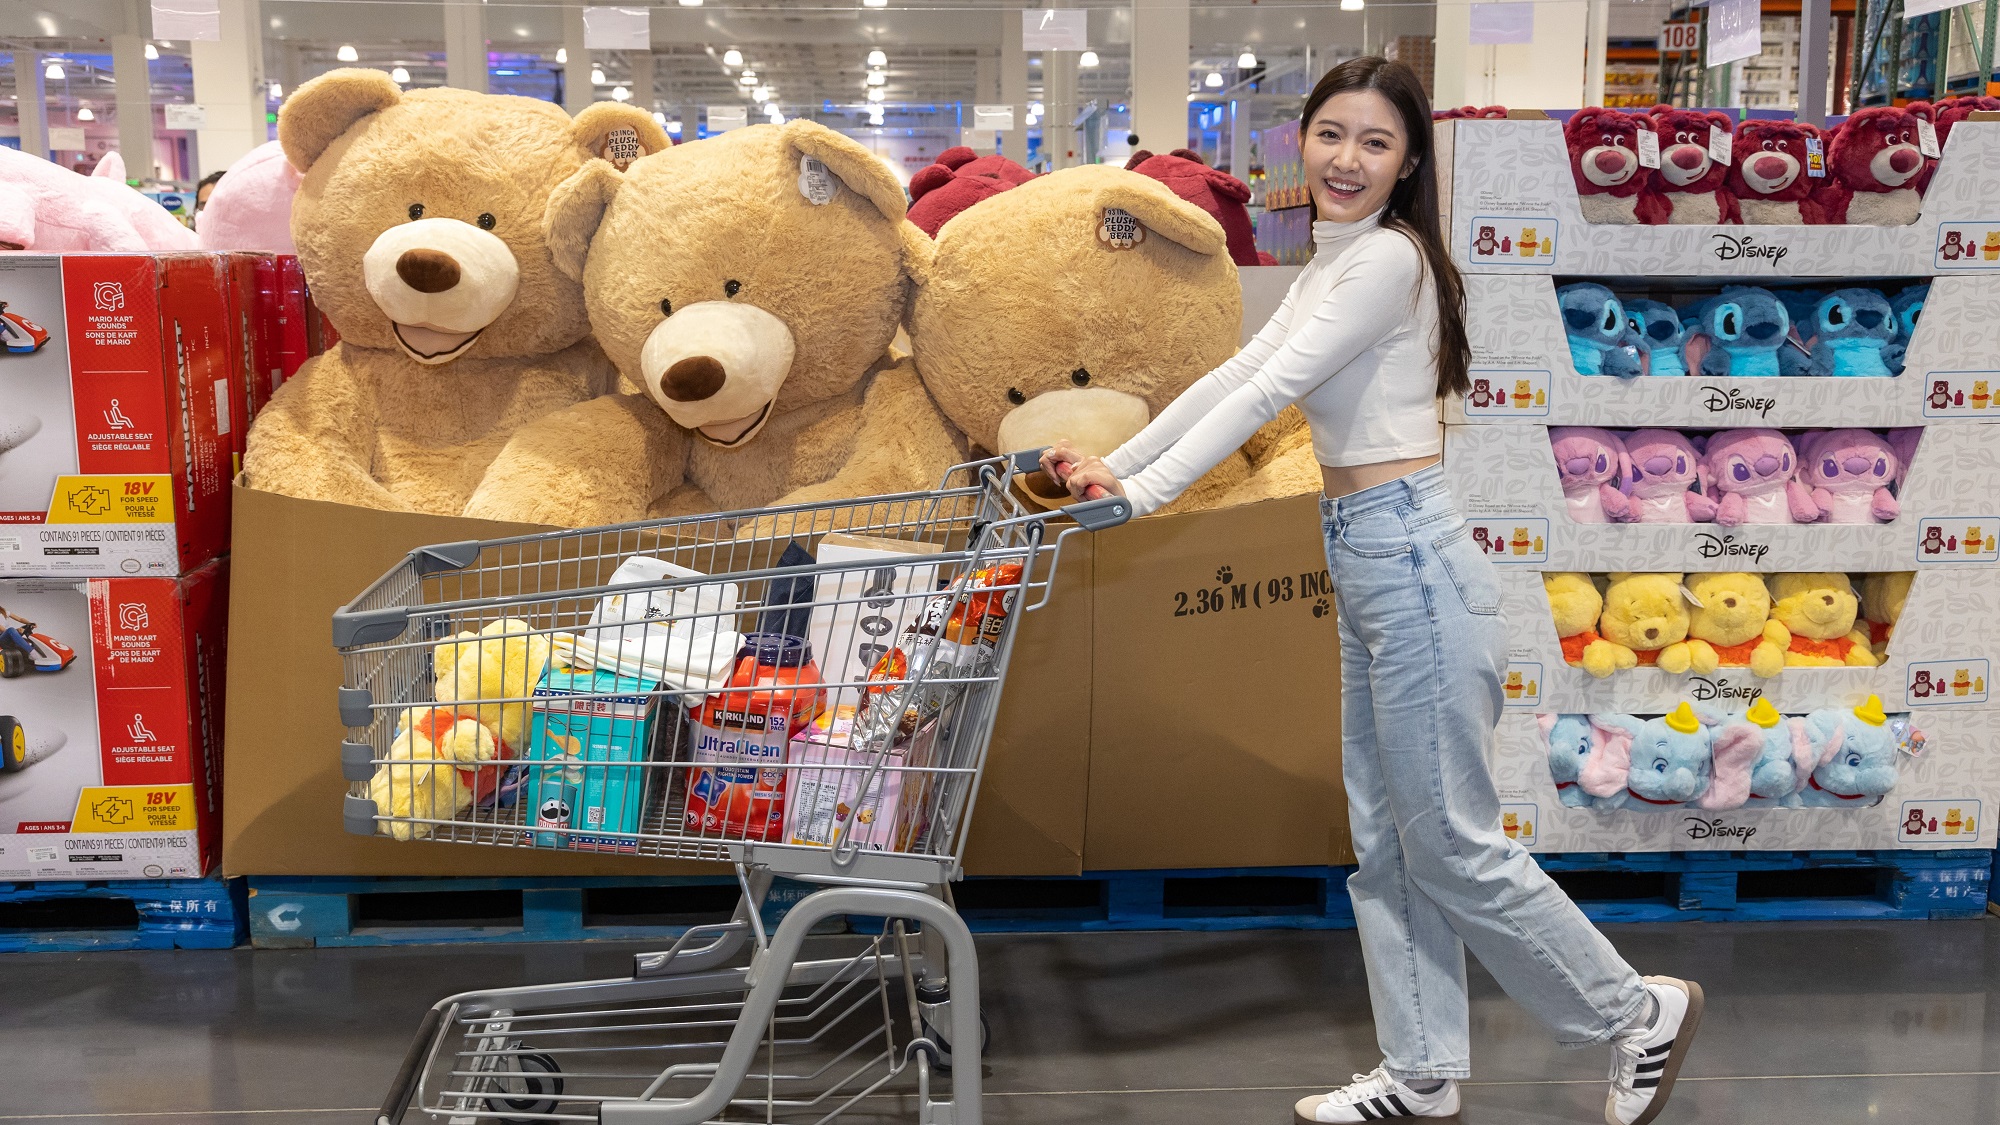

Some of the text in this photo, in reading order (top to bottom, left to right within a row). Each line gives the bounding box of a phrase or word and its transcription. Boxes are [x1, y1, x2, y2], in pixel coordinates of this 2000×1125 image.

[1664, 26, 1696, 48] 108
[608, 137, 638, 145] PLUSH
[609, 144, 640, 152] TEDDY
[614, 151, 638, 159] BEAR
[1104, 216, 1136, 225] PLUSH
[1105, 224, 1136, 232] TEDDY
[1110, 232, 1134, 240] BEAR
[124, 481, 155, 495] 18V
[40, 531, 72, 542] CONTAINS
[72, 531, 80, 542] 91
[81, 531, 101, 542] PIECES
[105, 530, 136, 542] CONTIENT
[137, 530, 144, 541] 91
[145, 528, 166, 541] PIÈCES
[1174, 586, 1225, 617] 2.36
[1230, 583, 1247, 610] M
[769, 716, 785, 726] 152
[147, 791, 177, 805] 18V
[65, 839, 96, 850] CONTAINS
[96, 839, 104, 850] 91
[104, 838, 124, 849] PIECES
[128, 838, 158, 849] CONTIENT
[158, 837, 166, 848] 91
[167, 836, 187, 848] PIÈCES
